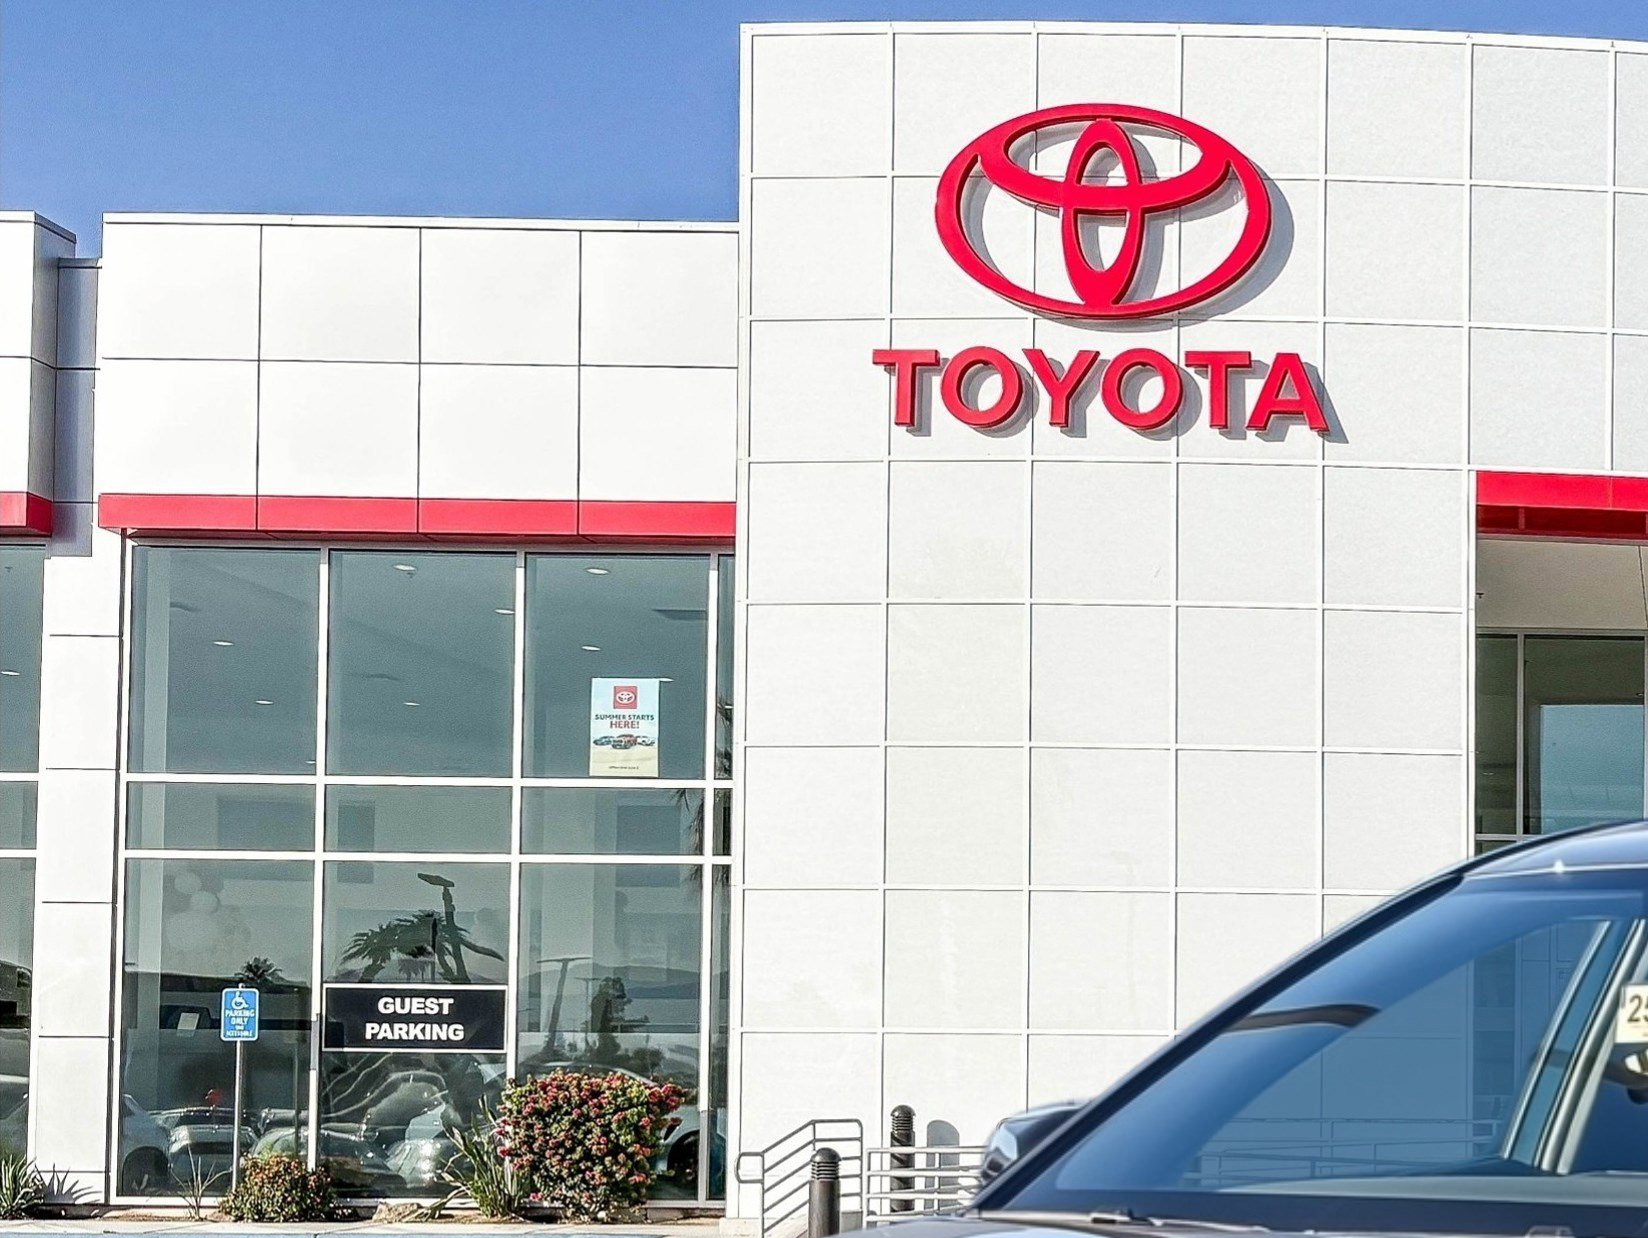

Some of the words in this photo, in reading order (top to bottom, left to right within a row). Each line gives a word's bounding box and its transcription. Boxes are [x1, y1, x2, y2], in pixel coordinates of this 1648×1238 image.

[873, 345, 1330, 433] TOYOTA
[609, 721, 640, 729] HERE!
[377, 997, 455, 1015] GUEST
[365, 1022, 465, 1041] PARKING
